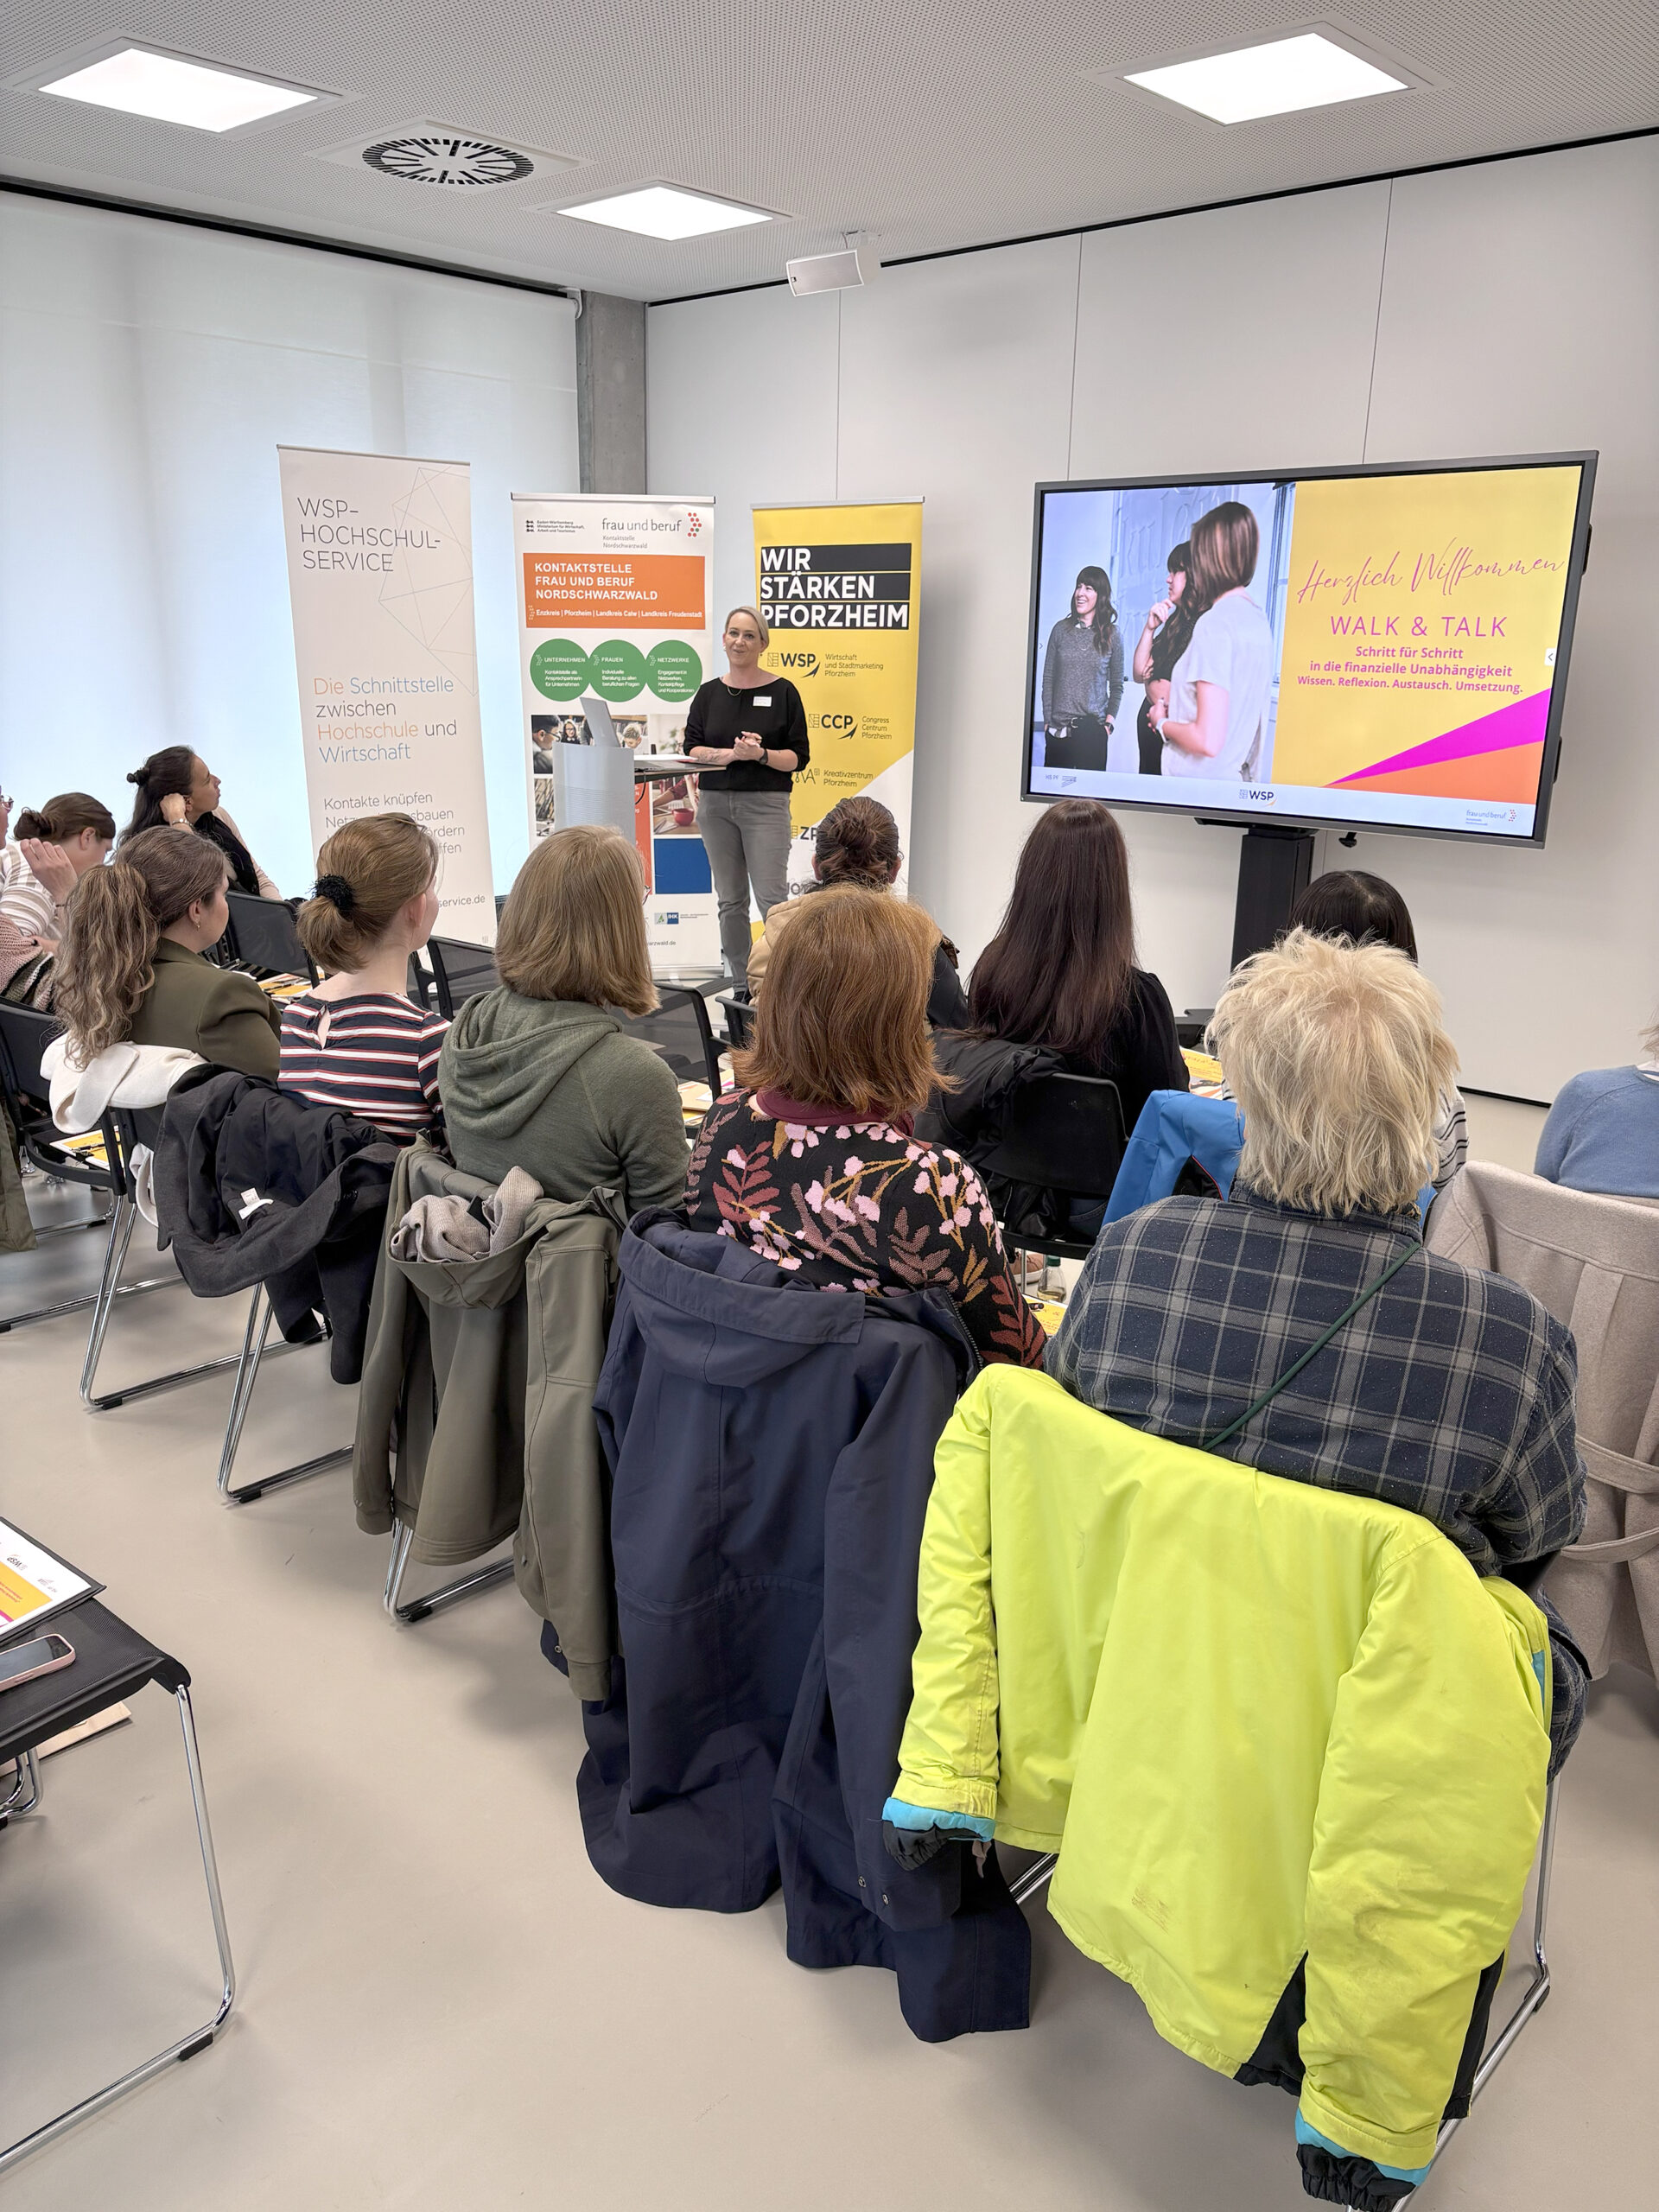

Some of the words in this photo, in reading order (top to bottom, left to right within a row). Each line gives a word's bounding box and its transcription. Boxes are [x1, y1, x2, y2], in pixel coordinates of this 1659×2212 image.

[297, 497, 359, 518] WSP-
[602, 518, 624, 531] frau
[627, 518, 648, 531] und
[651, 519, 682, 531] beruf
[300, 524, 441, 549] HOCHSCHUL-
[302, 550, 394, 572] SERVICE
[535, 563, 632, 574] KONTAKTSTELLE
[761, 548, 811, 571] WIR
[1297, 550, 1404, 605] Herzlich
[1411, 537, 1564, 596] Willkommen
[535, 576, 566, 586] FRAU
[569, 576, 594, 587] UND
[597, 577, 635, 587] BERUF
[760, 571, 875, 599] STÄRKEN
[536, 589, 658, 601] NORDSCHWARZWALD
[761, 604, 908, 628] PFORZHEIM
[1331, 616, 1400, 636] WALK
[1411, 616, 1427, 637] &
[1441, 616, 1508, 638] TALK
[780, 653, 816, 667] WSP
[1355, 646, 1396, 658] Schritt
[1399, 646, 1418, 658] für
[1421, 647, 1464, 659] Schritt
[839, 662, 884, 671] Stadtmarketing
[1310, 661, 1321, 671] in
[1324, 661, 1341, 672] die
[1344, 661, 1407, 674] finanzielle
[1410, 663, 1513, 679] Unabhängigkeit
[314, 677, 344, 695] Die
[350, 676, 454, 694] Schnittstelle
[1297, 676, 1335, 686] Wissen.
[1338, 677, 1389, 688] Reflexion.
[1392, 678, 1452, 690] Austausch.
[1456, 681, 1523, 695] Umsetzung.
[316, 700, 397, 718] zwischen
[821, 715, 854, 729] CCP
[861, 716, 890, 725] Congress
[317, 721, 419, 741] Hochschule
[425, 719, 457, 736] und
[319, 743, 411, 763] Wirtschaft
[823, 769, 873, 779] Kreativzentrum
[823, 779, 857, 787] Pforzheim
[324, 795, 380, 810] Kontakte
[384, 792, 433, 807] knüpfen
[1249, 790, 1274, 801] WSP
[410, 809, 454, 822] sbauen
[438, 894, 486, 908] service.de
